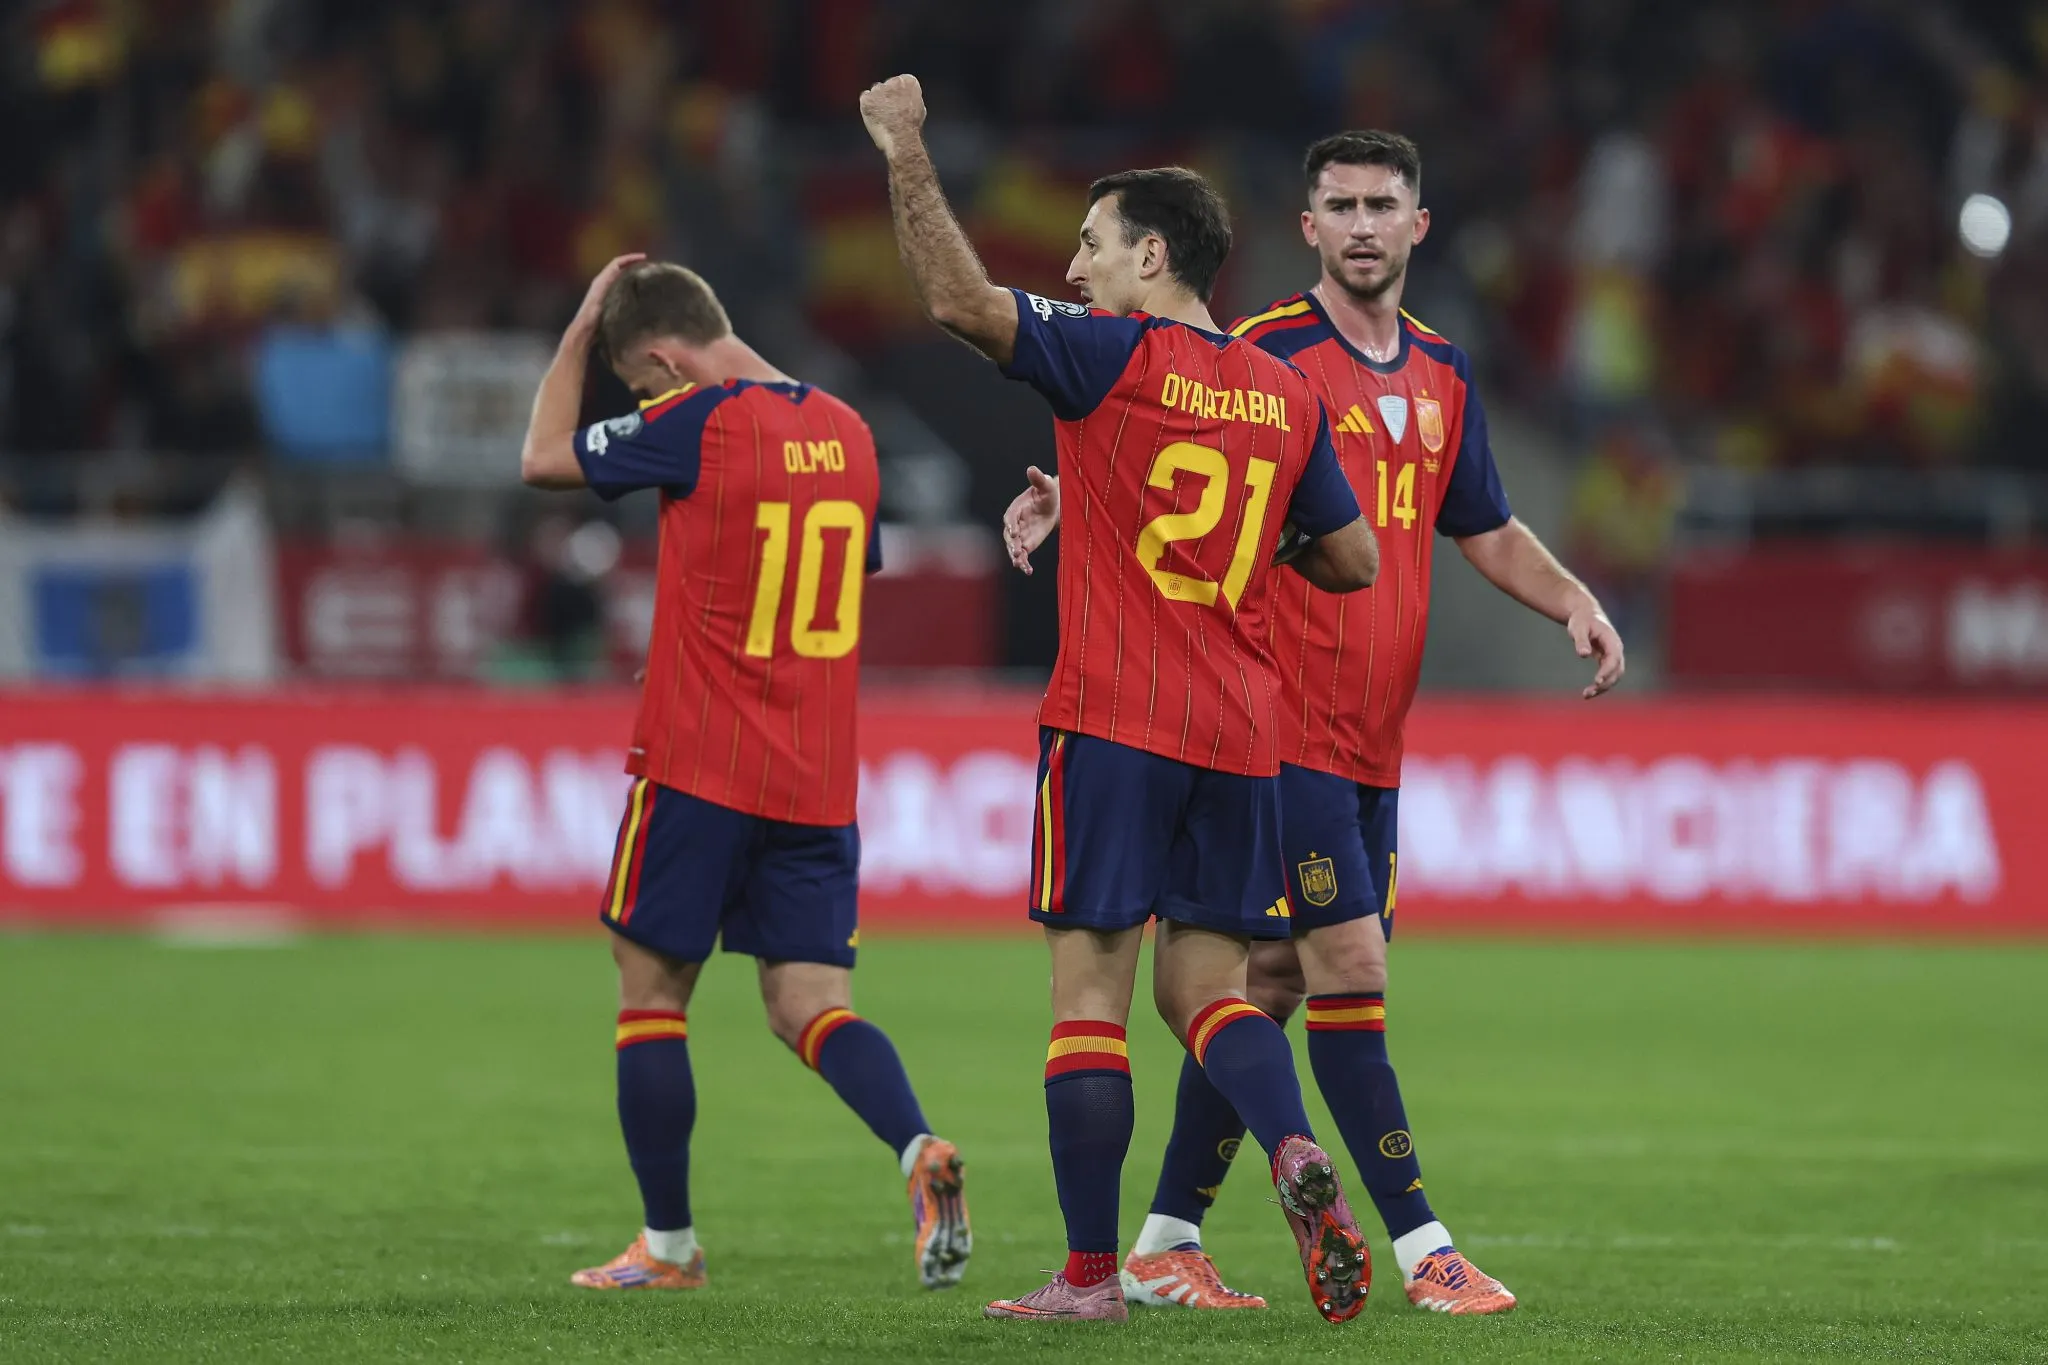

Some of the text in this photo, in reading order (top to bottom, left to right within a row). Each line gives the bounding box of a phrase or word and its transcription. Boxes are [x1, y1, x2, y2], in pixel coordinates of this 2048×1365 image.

[1161, 372, 1290, 432] OYARZABAL
[784, 440, 845, 473] OLMO
[1376, 460, 1416, 530] 14
[745, 501, 865, 659] 10
[1136, 441, 1277, 614] 21
[109, 743, 278, 890] EN
